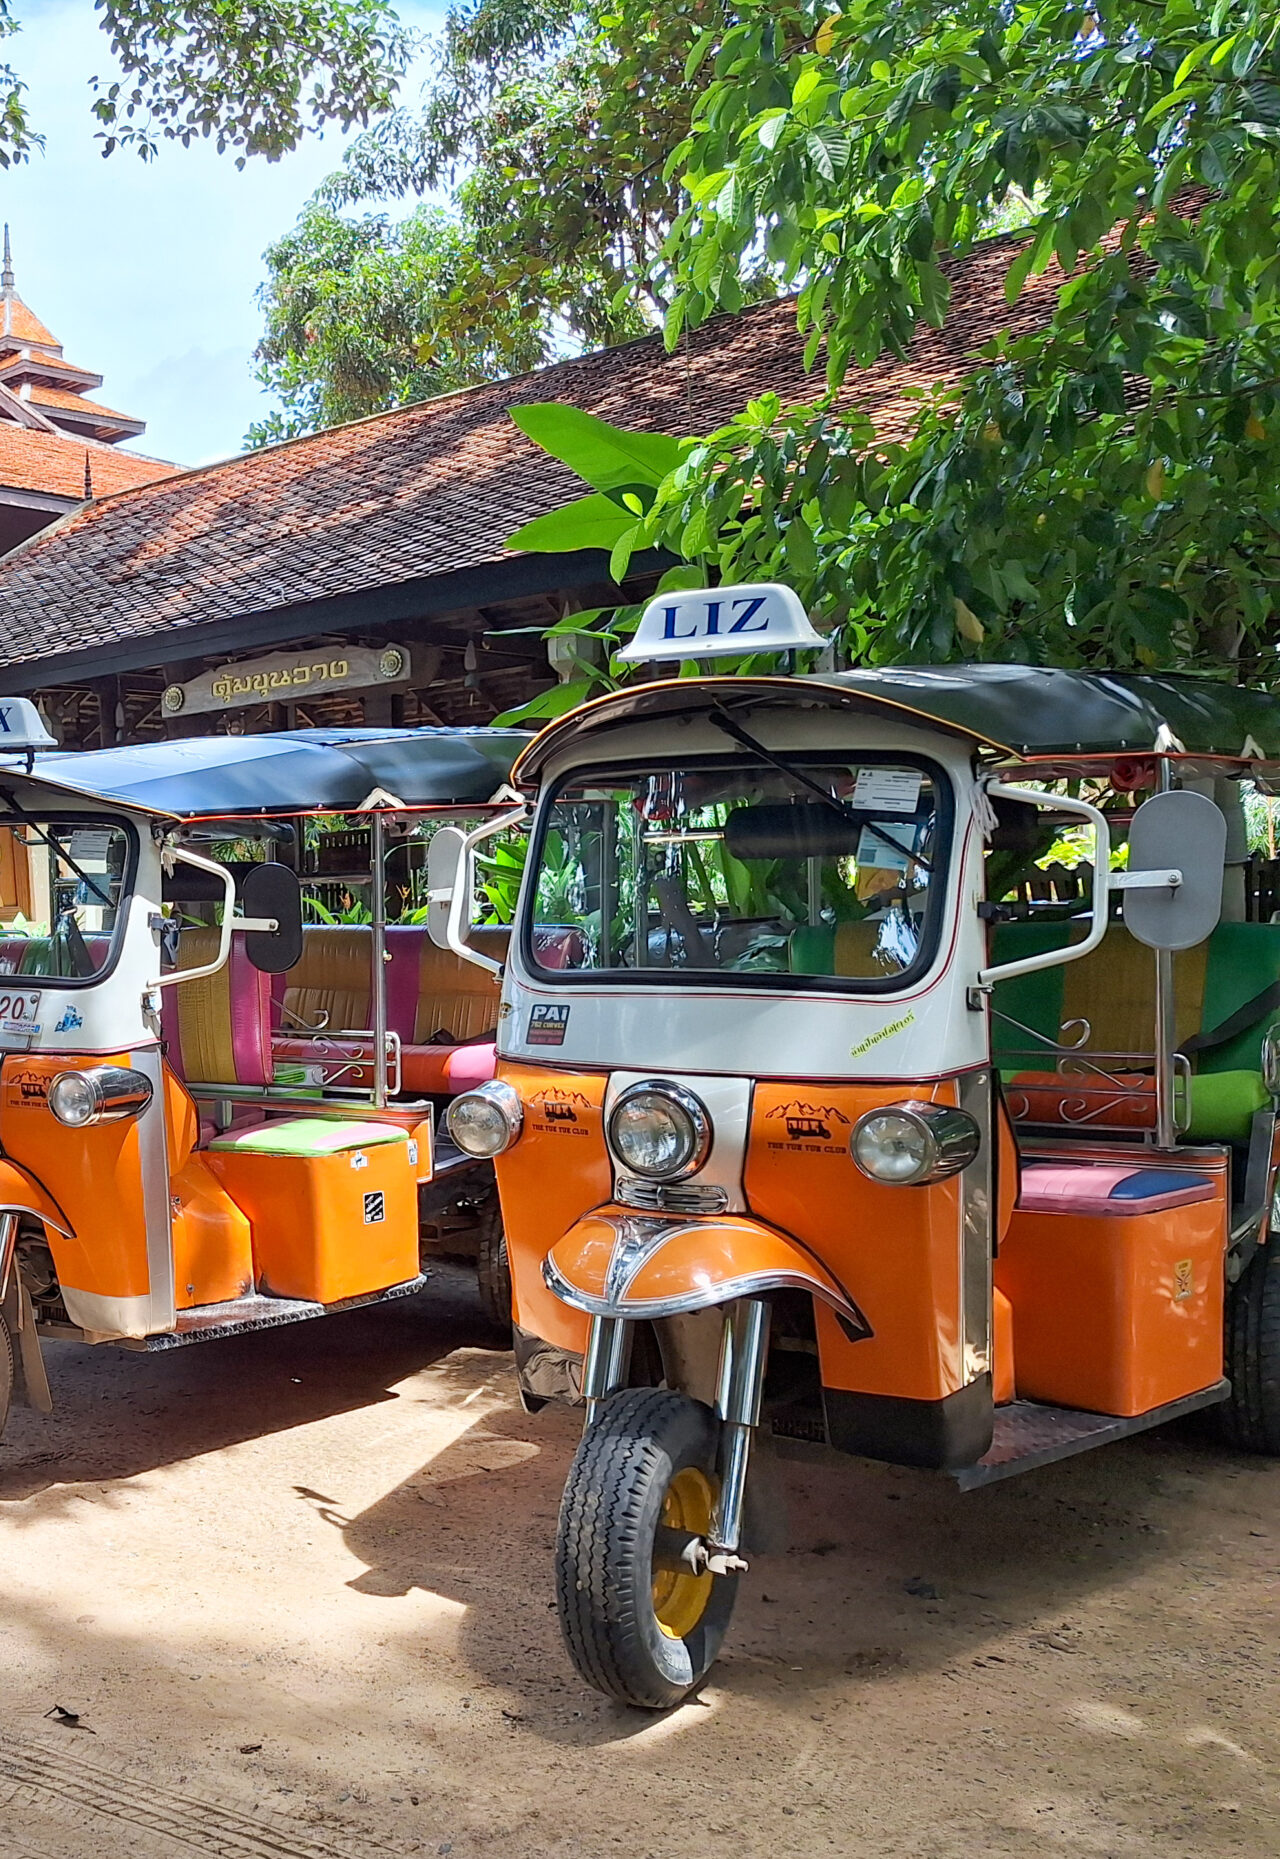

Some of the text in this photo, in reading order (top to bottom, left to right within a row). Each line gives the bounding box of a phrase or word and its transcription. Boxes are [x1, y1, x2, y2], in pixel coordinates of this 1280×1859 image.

[658, 596, 770, 640] LIZ
[559, 1126, 571, 1134] TUK
[786, 1143, 802, 1151] TUK
[805, 1144, 821, 1152] TUK
[824, 1146, 847, 1154] CLUB
